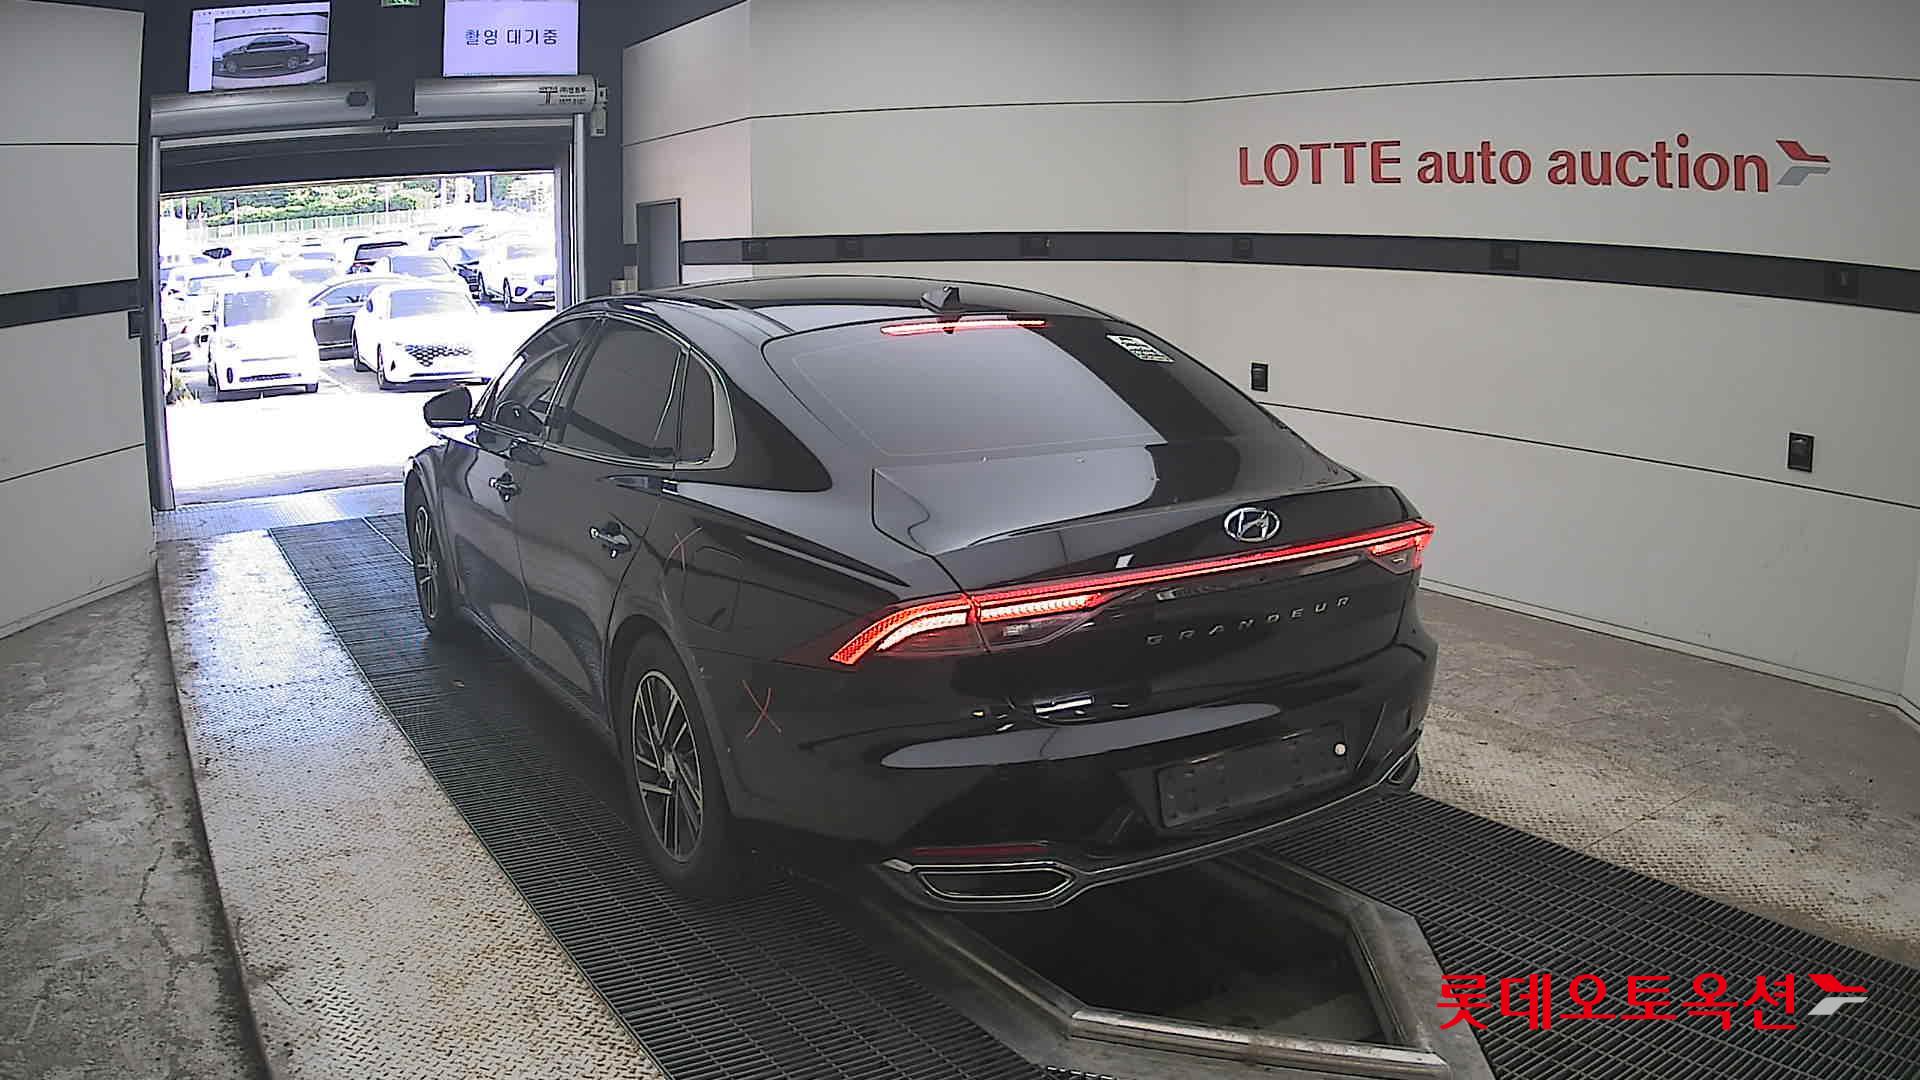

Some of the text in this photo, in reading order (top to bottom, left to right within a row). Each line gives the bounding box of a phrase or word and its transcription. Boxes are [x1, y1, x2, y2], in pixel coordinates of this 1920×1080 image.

[1239, 133, 1769, 193] LOTTE auto auction
[1146, 596, 1350, 645] GRANDEUR
